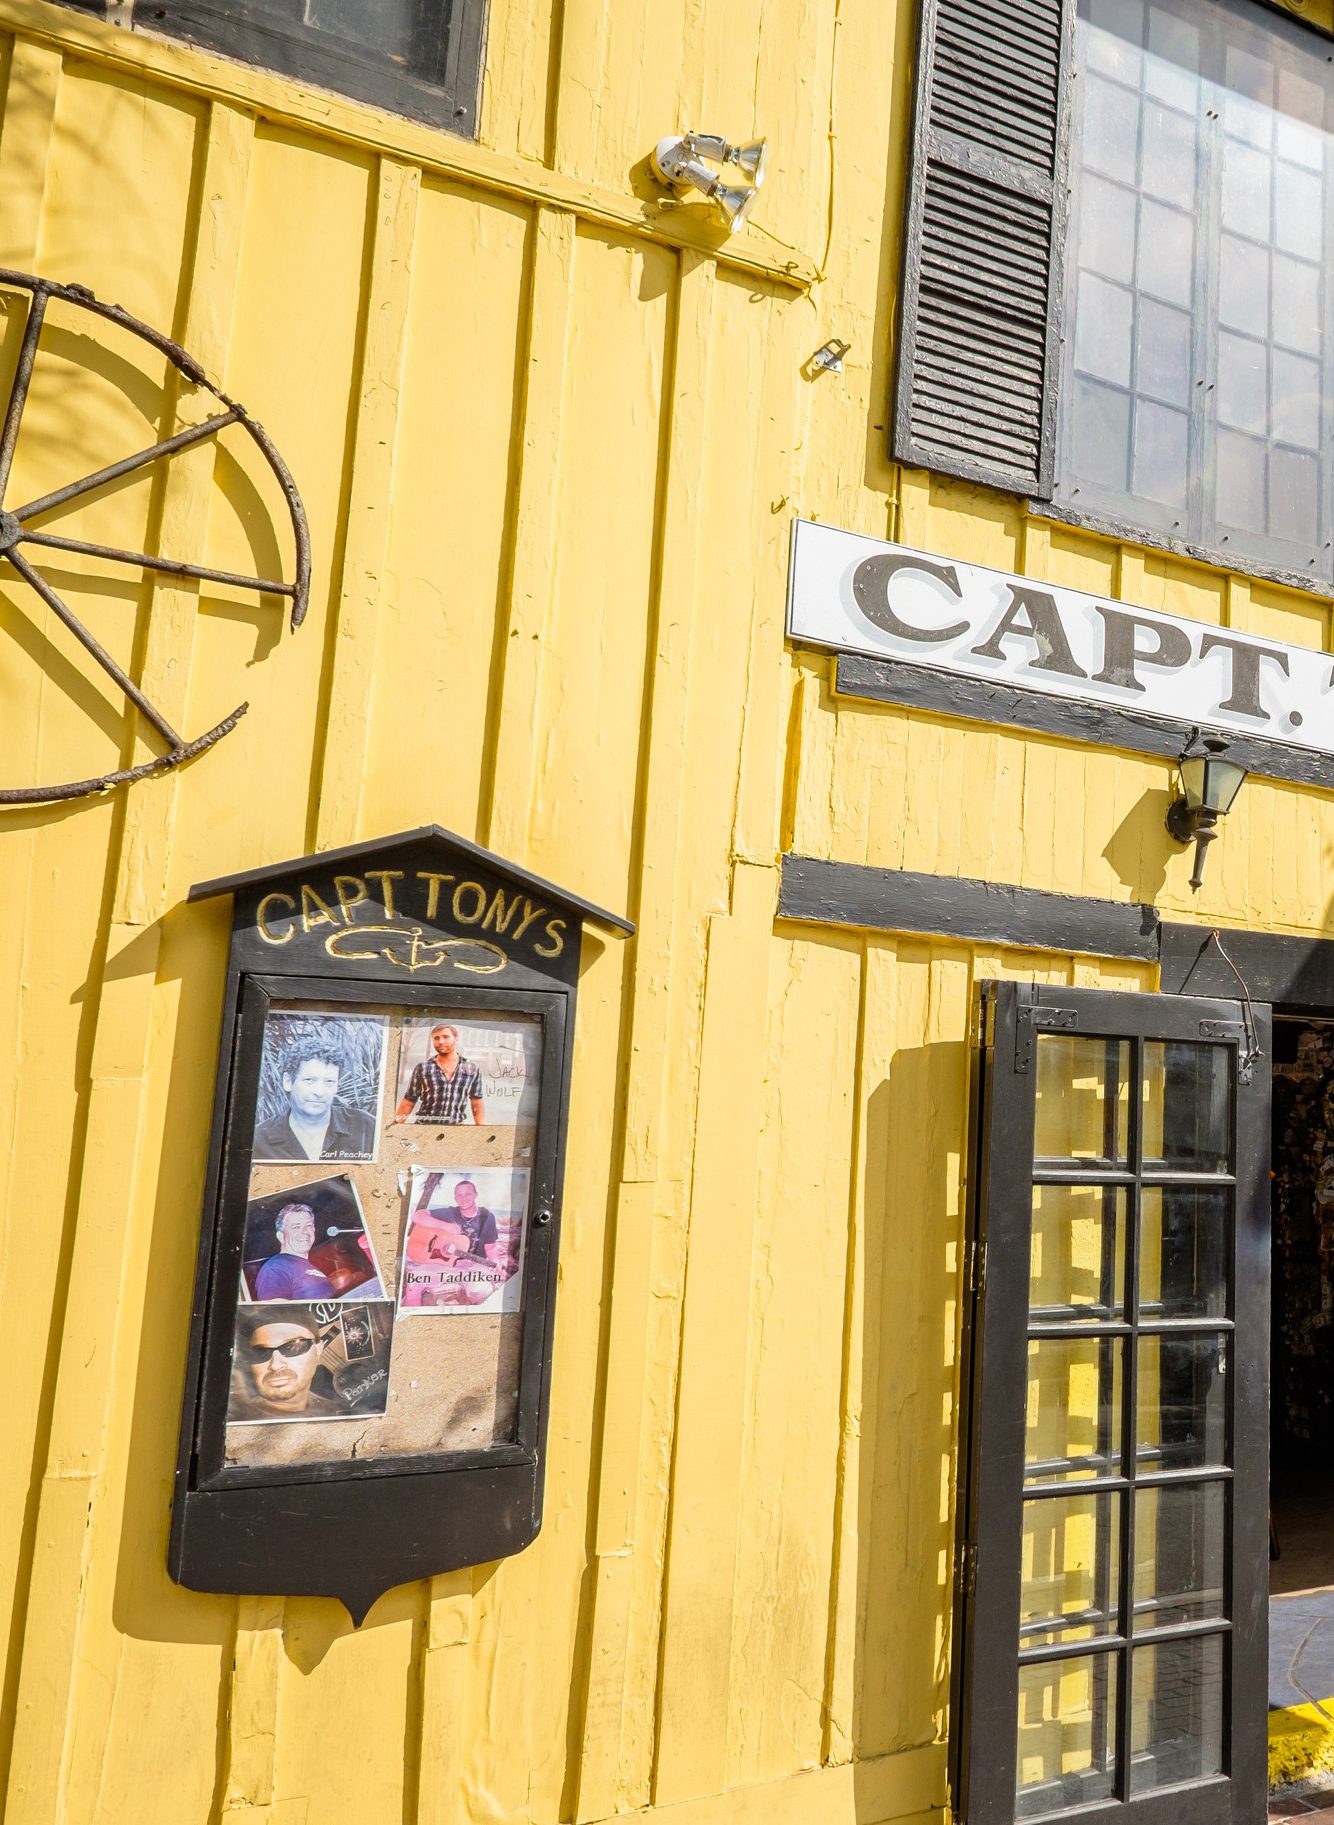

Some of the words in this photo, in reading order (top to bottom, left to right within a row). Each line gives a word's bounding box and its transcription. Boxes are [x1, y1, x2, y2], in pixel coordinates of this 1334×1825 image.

[848, 552, 1304, 729] CAPT.
[256, 870, 405, 945] CAPT
[415, 871, 567, 958] TONYS
[488, 1058, 529, 1079] JACK
[485, 1080, 522, 1098] WOLF
[319, 1150, 338, 1158] Carl
[339, 1150, 375, 1160] Peachey
[407, 1271, 431, 1284] Ben
[438, 1270, 502, 1283] Taddiken
